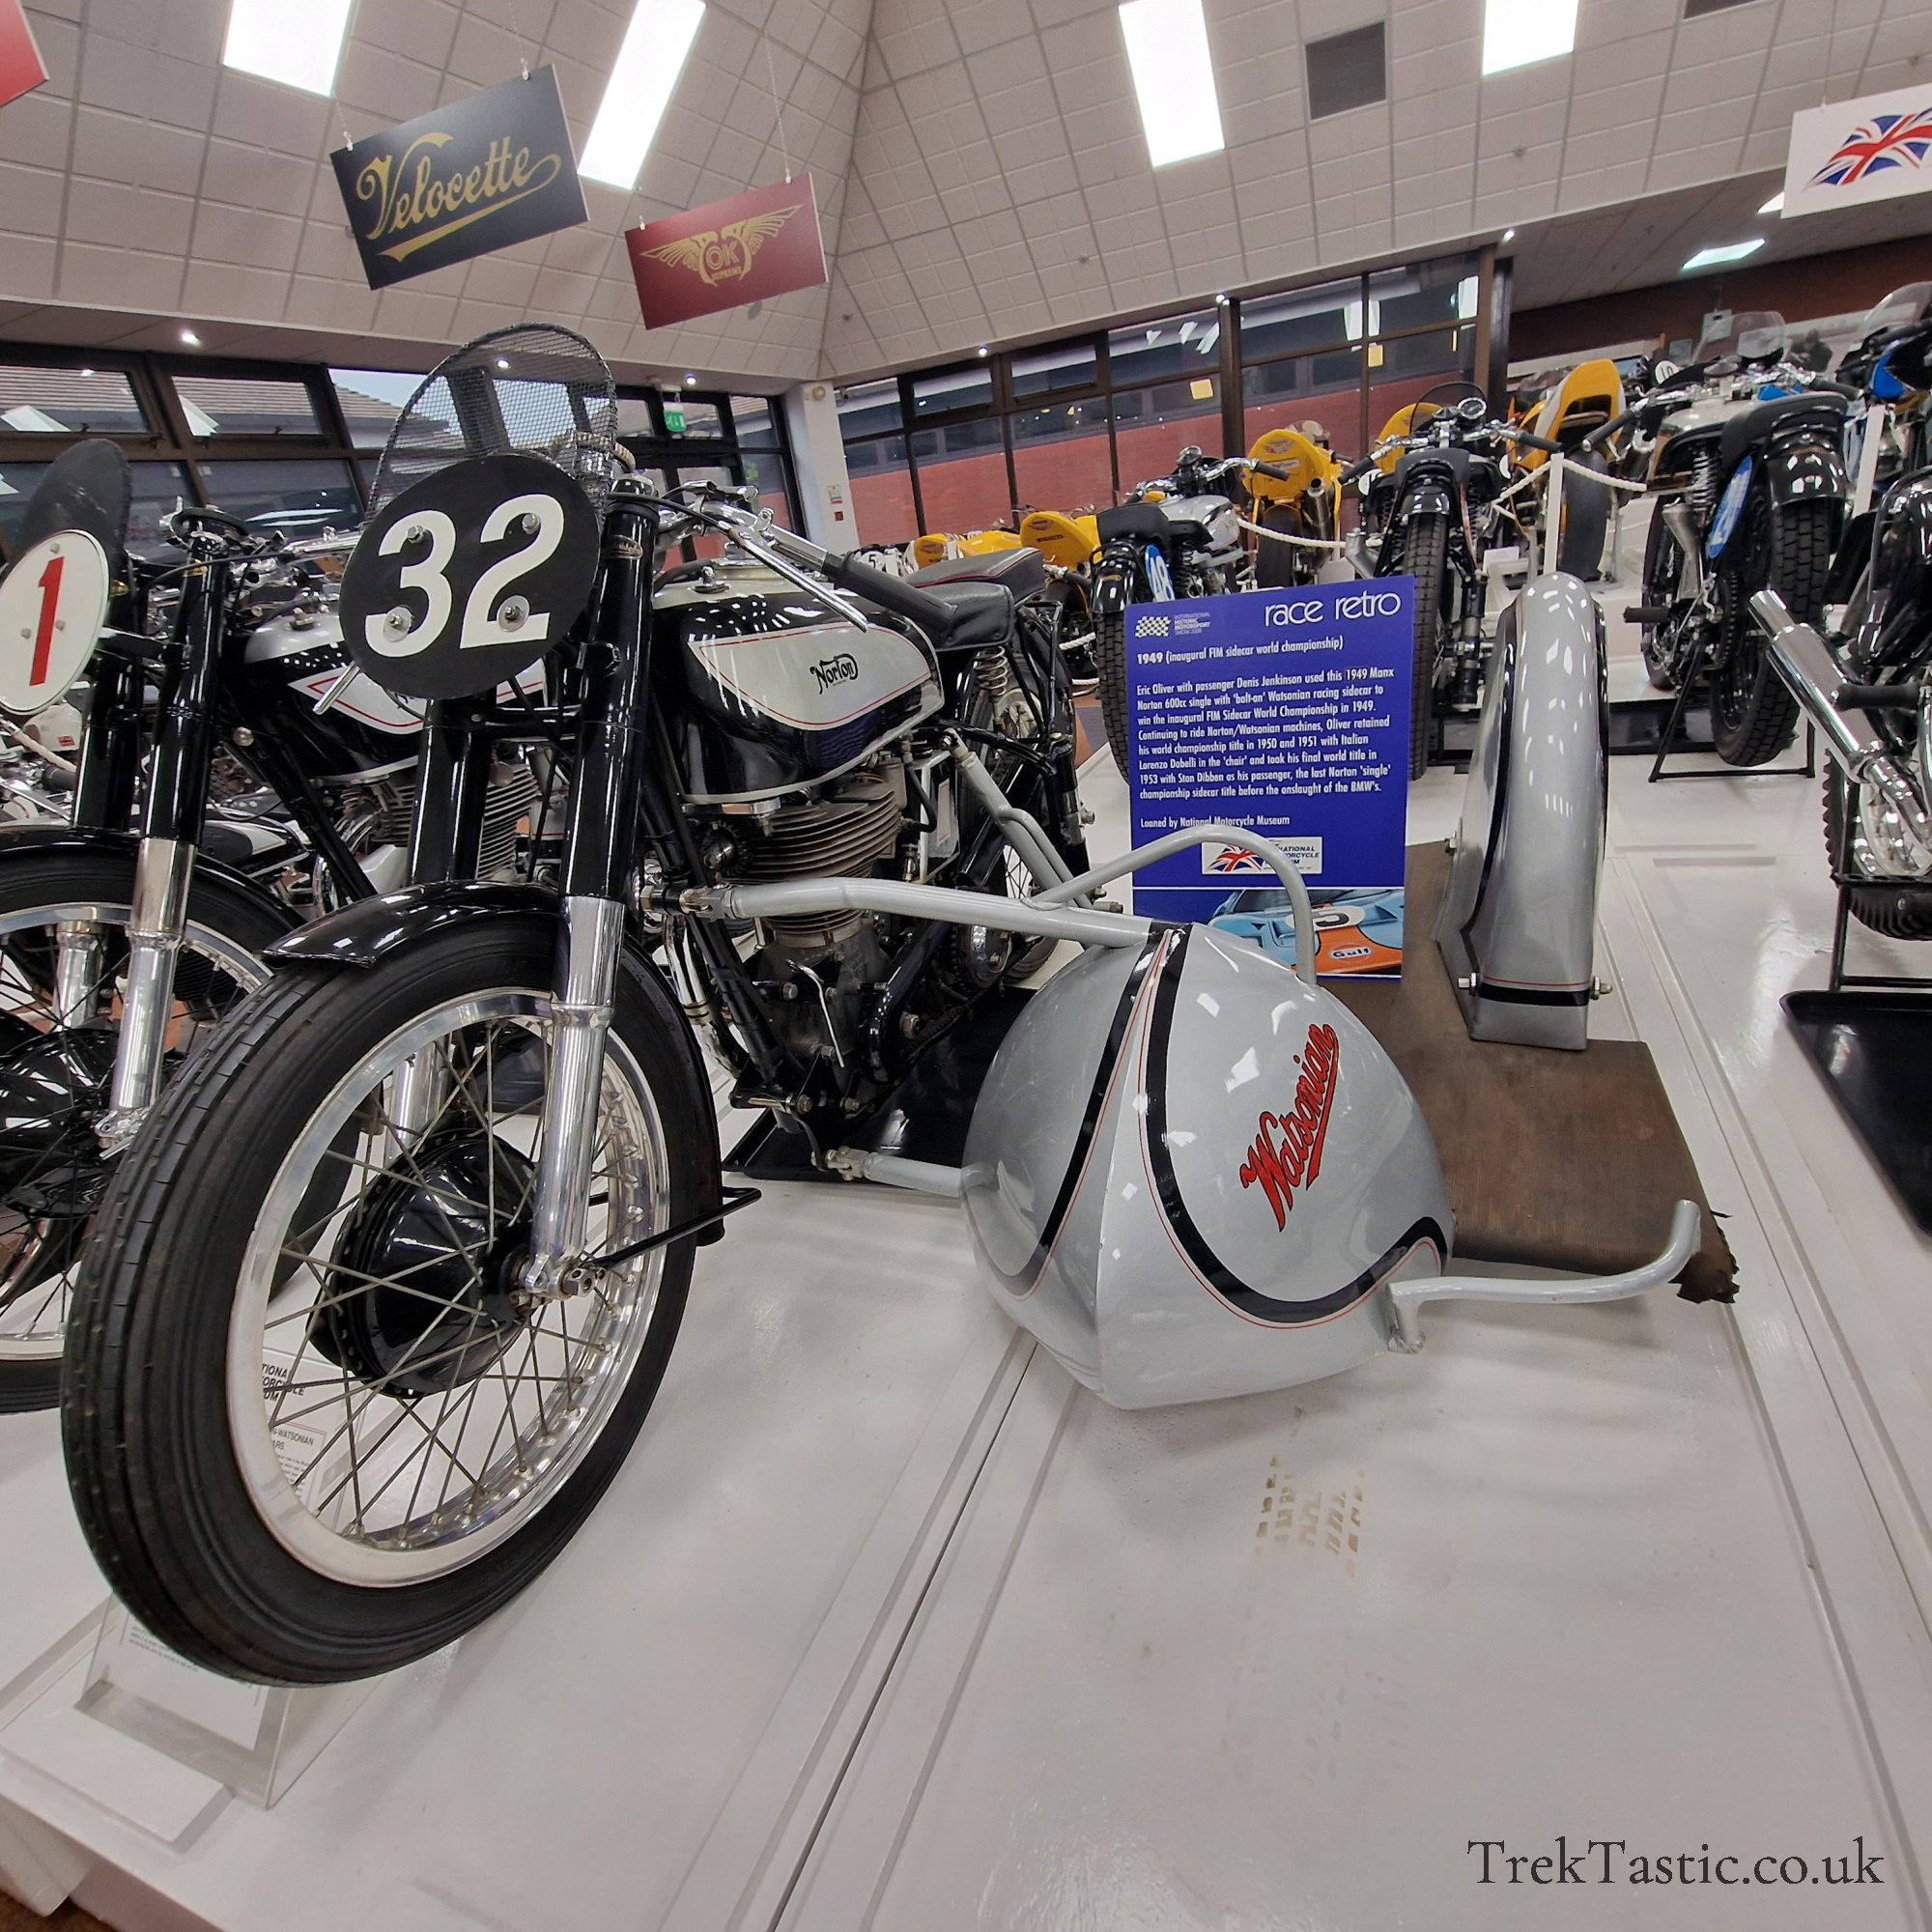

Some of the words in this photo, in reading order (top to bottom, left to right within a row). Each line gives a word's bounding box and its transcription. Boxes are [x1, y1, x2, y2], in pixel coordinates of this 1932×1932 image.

[356, 132, 561, 261] Velocette
[706, 241, 740, 270] OK
[365, 493, 564, 658] 32
[1265, 601, 1323, 627] race
[1335, 590, 1401, 620] retro
[30, 556, 65, 688] 1
[1137, 652, 1163, 665] 1949
[1166, 647, 1206, 665] (inaugural
[1209, 647, 1223, 658] FIM
[1226, 644, 1254, 657] sidecar
[1256, 640, 1279, 654] world
[1281, 635, 1344, 653] championship)
[810, 653, 858, 695] Norton
[1137, 685, 1151, 696] Eric
[1152, 683, 1174, 695] Oliver
[1177, 680, 1192, 693] with
[1196, 680, 1235, 694] passenger
[1237, 677, 1259, 688] Denis
[1262, 673, 1302, 687] Jenkinson
[1305, 670, 1324, 683] used
[1327, 669, 1342, 681] this
[1347, 668, 1367, 680] 1949
[1370, 667, 1394, 678] Manx
[1138, 700, 1162, 710] Norton
[1165, 697, 1186, 708] 600cc
[1189, 695, 1211, 708] single
[1214, 694, 1230, 705] with
[1234, 692, 1265, 704] 'bolt-on'
[1268, 690, 1310, 701] Watsonian
[1314, 688, 1339, 699] racing
[1342, 685, 1372, 696] sidecar
[1375, 685, 1383, 695] to
[1138, 716, 1151, 725] win
[1153, 714, 1165, 724] the
[1168, 711, 1204, 724] inaugural
[1207, 711, 1220, 721] FIM
[1223, 709, 1251, 720] Sidecar
[1254, 706, 1277, 718] World
[1280, 702, 1338, 718] Championship
[1341, 703, 1349, 713] in
[1352, 700, 1376, 712] 1949.
[1138, 730, 1178, 741] Continuing
[1180, 729, 1187, 738] to
[1190, 725, 1205, 737] ride
[1208, 724, 1280, 737] Norton/Watsonian
[1283, 720, 1323, 732] machines,
[1326, 718, 1351, 729] Oliver
[1354, 715, 1390, 727] retained
[1139, 745, 1150, 755] his
[1151, 743, 1172, 753] world
[1175, 741, 1226, 754] championship
[1229, 740, 1243, 751] title
[1247, 740, 1254, 750] in
[1258, 738, 1277, 749] 1950
[1280, 737, 1294, 748] and
[1298, 736, 1317, 747] 1951
[1321, 734, 1338, 746] with
[1342, 733, 1368, 745] Italian
[1139, 760, 1167, 770] Lorenzo
[1171, 756, 1196, 769] Dobelli
[1199, 757, 1206, 767] in
[1208, 756, 1220, 766] the
[1223, 755, 1247, 765] 'chair'
[1250, 753, 1264, 765] and
[1267, 753, 1285, 764] took
[1288, 752, 1299, 763] his
[1302, 751, 1321, 762] final
[1323, 750, 1347, 762] world
[1350, 749, 1365, 760] title
[1369, 750, 1377, 759] in
[1140, 775, 1157, 784] 1953
[1160, 773, 1176, 783] with
[1179, 773, 1194, 782] Stan
[1197, 772, 1223, 782] Dibben
[1226, 773, 1235, 781] as
[1237, 770, 1248, 781] his
[1251, 771, 1293, 782] passenger,
[1295, 768, 1308, 779] the
[1311, 767, 1325, 778] last
[1329, 766, 1356, 777] Norton
[1360, 763, 1390, 778] 'single'
[1140, 786, 1190, 801] championship
[1192, 786, 1219, 797] sidecar
[1221, 785, 1236, 796] title
[1238, 784, 1264, 796] before
[1265, 783, 1279, 795] the
[1281, 782, 1321, 796] onslaught
[1323, 781, 1332, 792] of
[1335, 781, 1348, 792] the
[1351, 781, 1381, 792] BMW's.
[1141, 816, 1166, 827] Loaned
[1169, 816, 1178, 829] by
[1180, 815, 1211, 827] National
[1214, 814, 1254, 827] Motorcycle
[1257, 815, 1290, 825] Museum
[1333, 948, 1370, 958] Gulf
[1239, 1024, 1339, 1233] Watsonian
[262, 1363, 288, 1378] TIONA
